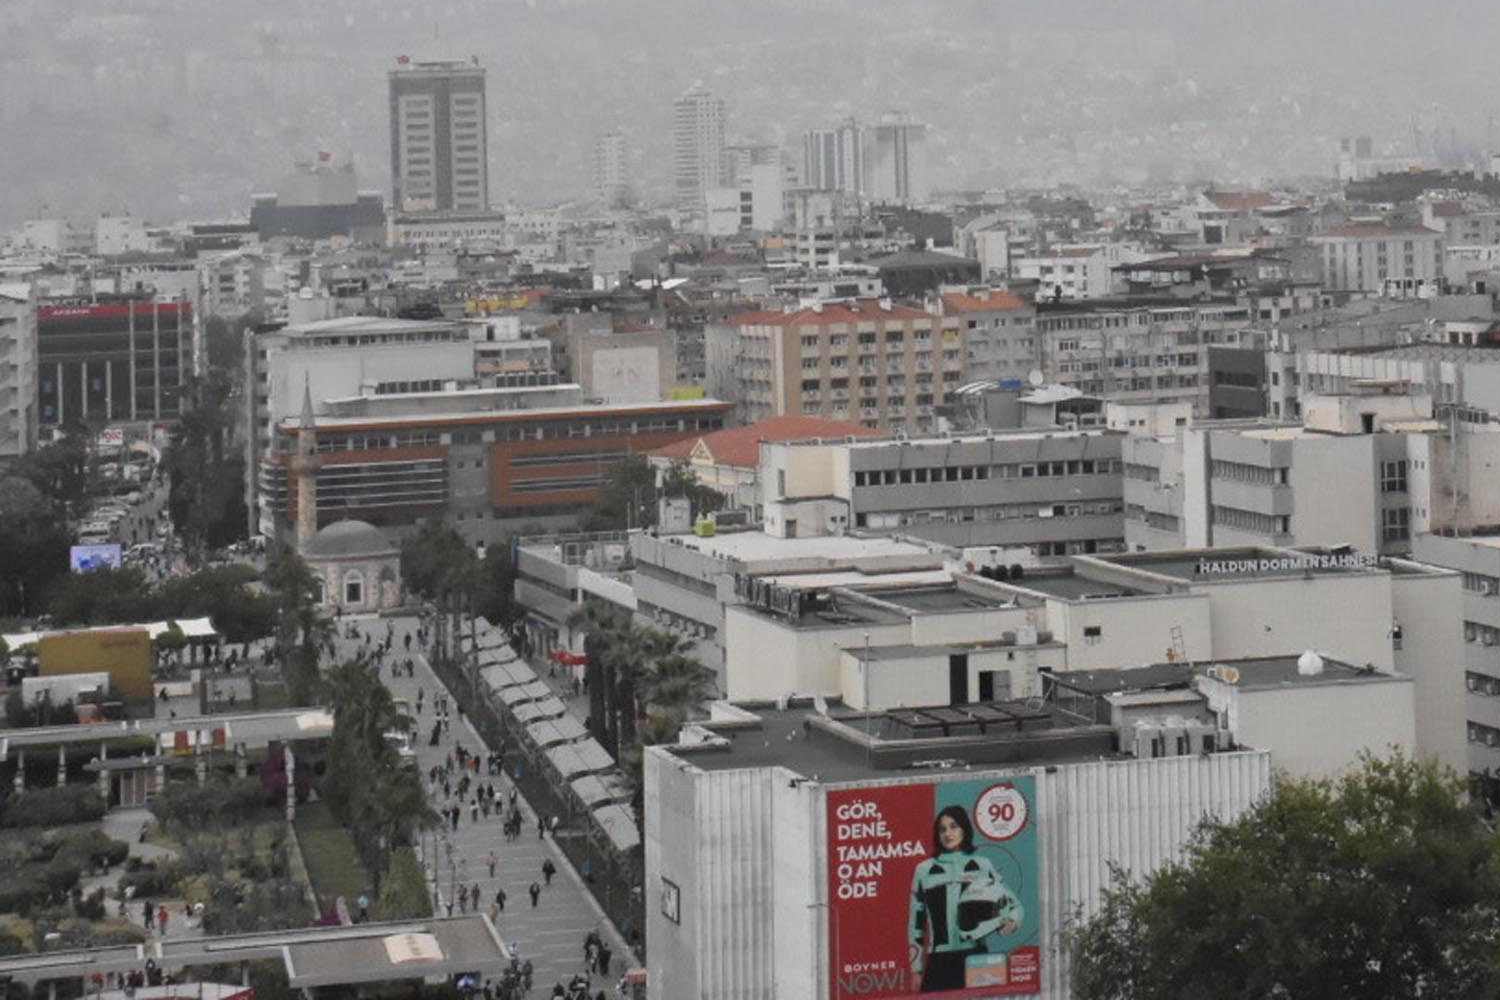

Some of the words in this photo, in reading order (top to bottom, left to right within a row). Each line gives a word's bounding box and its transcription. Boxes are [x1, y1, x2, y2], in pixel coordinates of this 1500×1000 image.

[1200, 560, 1257, 574] HALDUN
[1259, 556, 1319, 571] DORMEN
[836, 799, 882, 821] GÖR,
[988, 803, 1014, 823] 90
[838, 820, 892, 840] DENE,
[837, 840, 926, 862] TAMAMSA
[838, 863, 853, 879] O
[855, 861, 882, 878] AN
[838, 879, 877, 900] ÖDE
